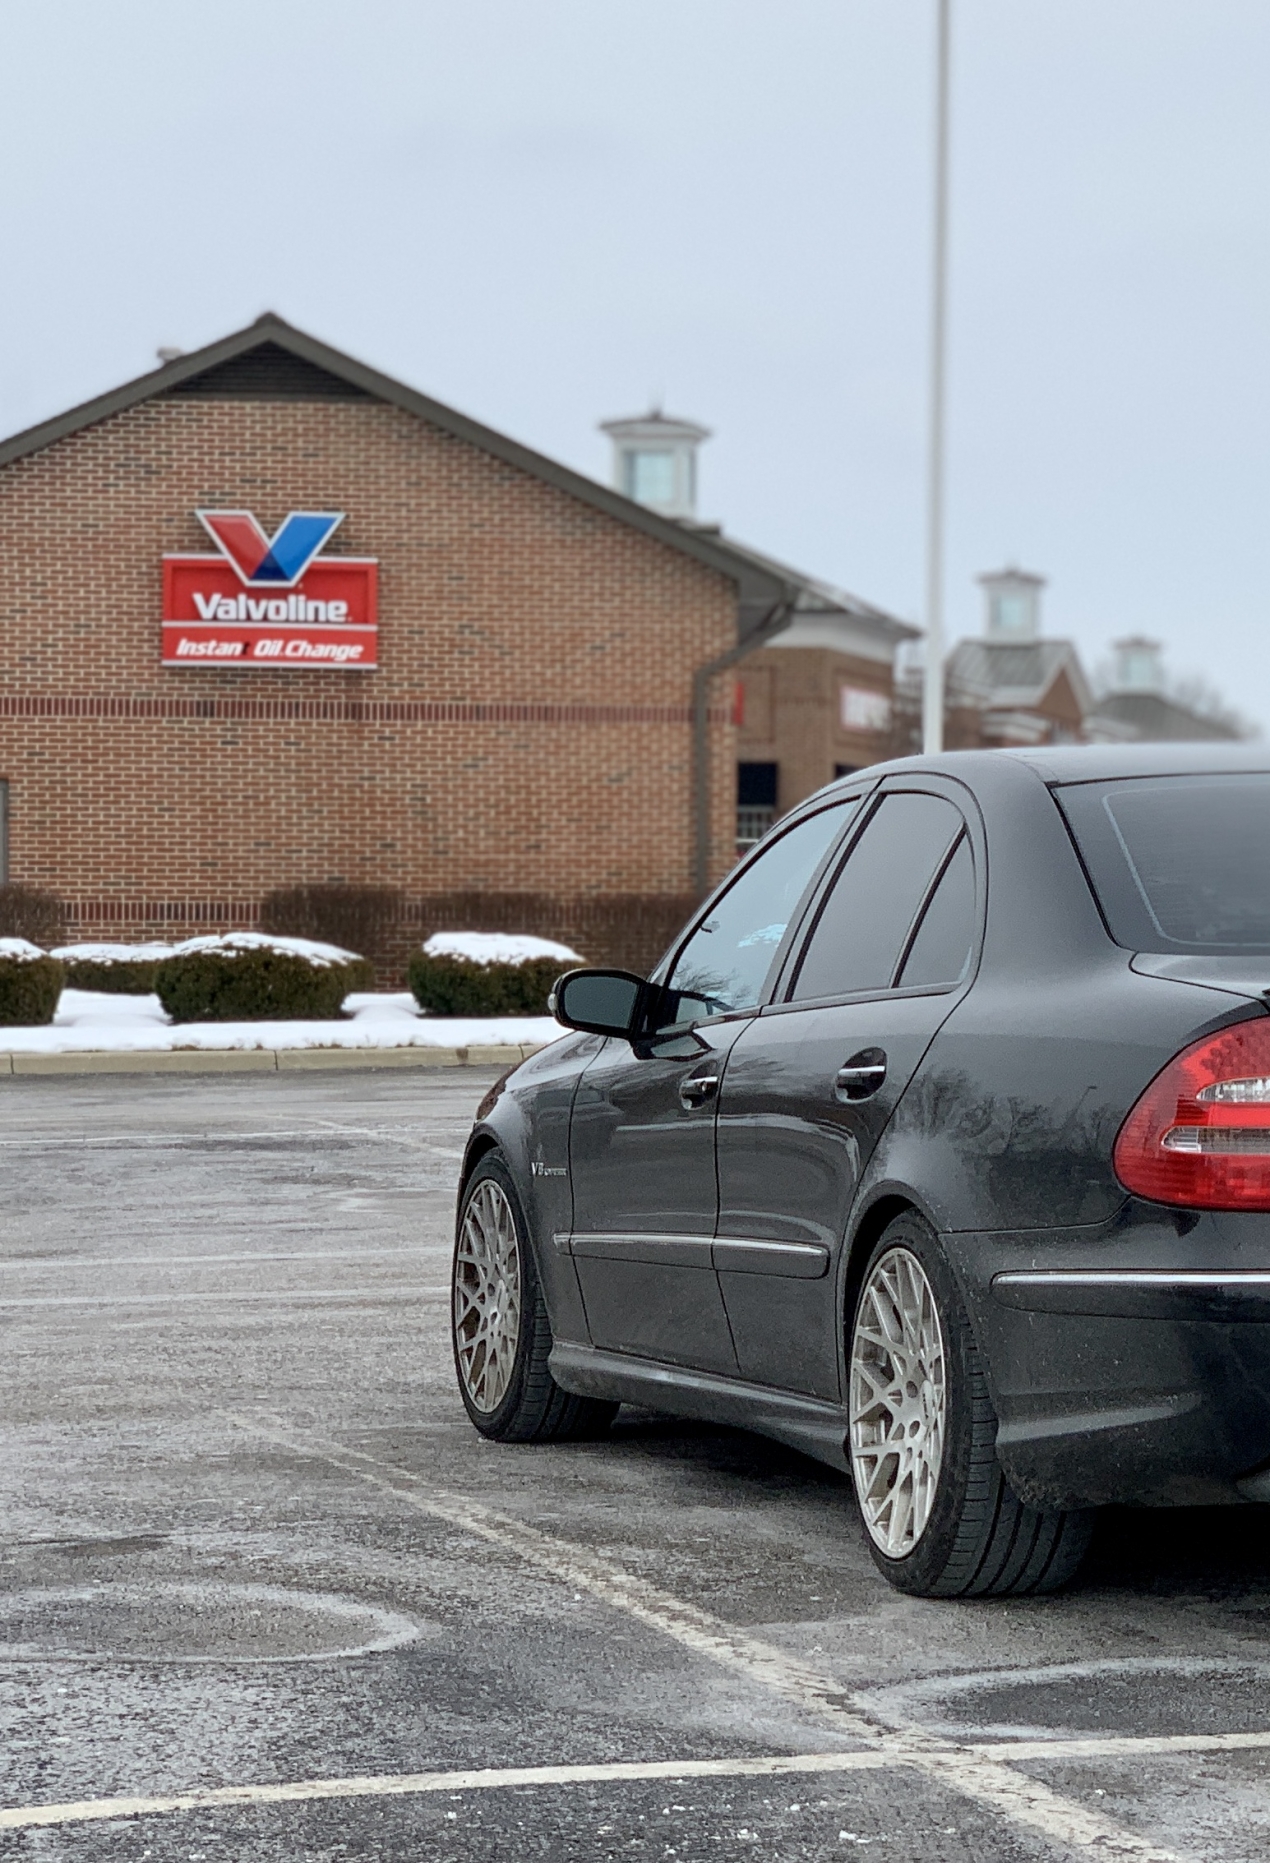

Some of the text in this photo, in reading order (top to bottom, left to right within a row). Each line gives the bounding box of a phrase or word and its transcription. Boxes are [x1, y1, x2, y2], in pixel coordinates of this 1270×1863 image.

[192, 593, 348, 623] Valvoline
[253, 639, 284, 657] Oil
[284, 639, 364, 662] Change
